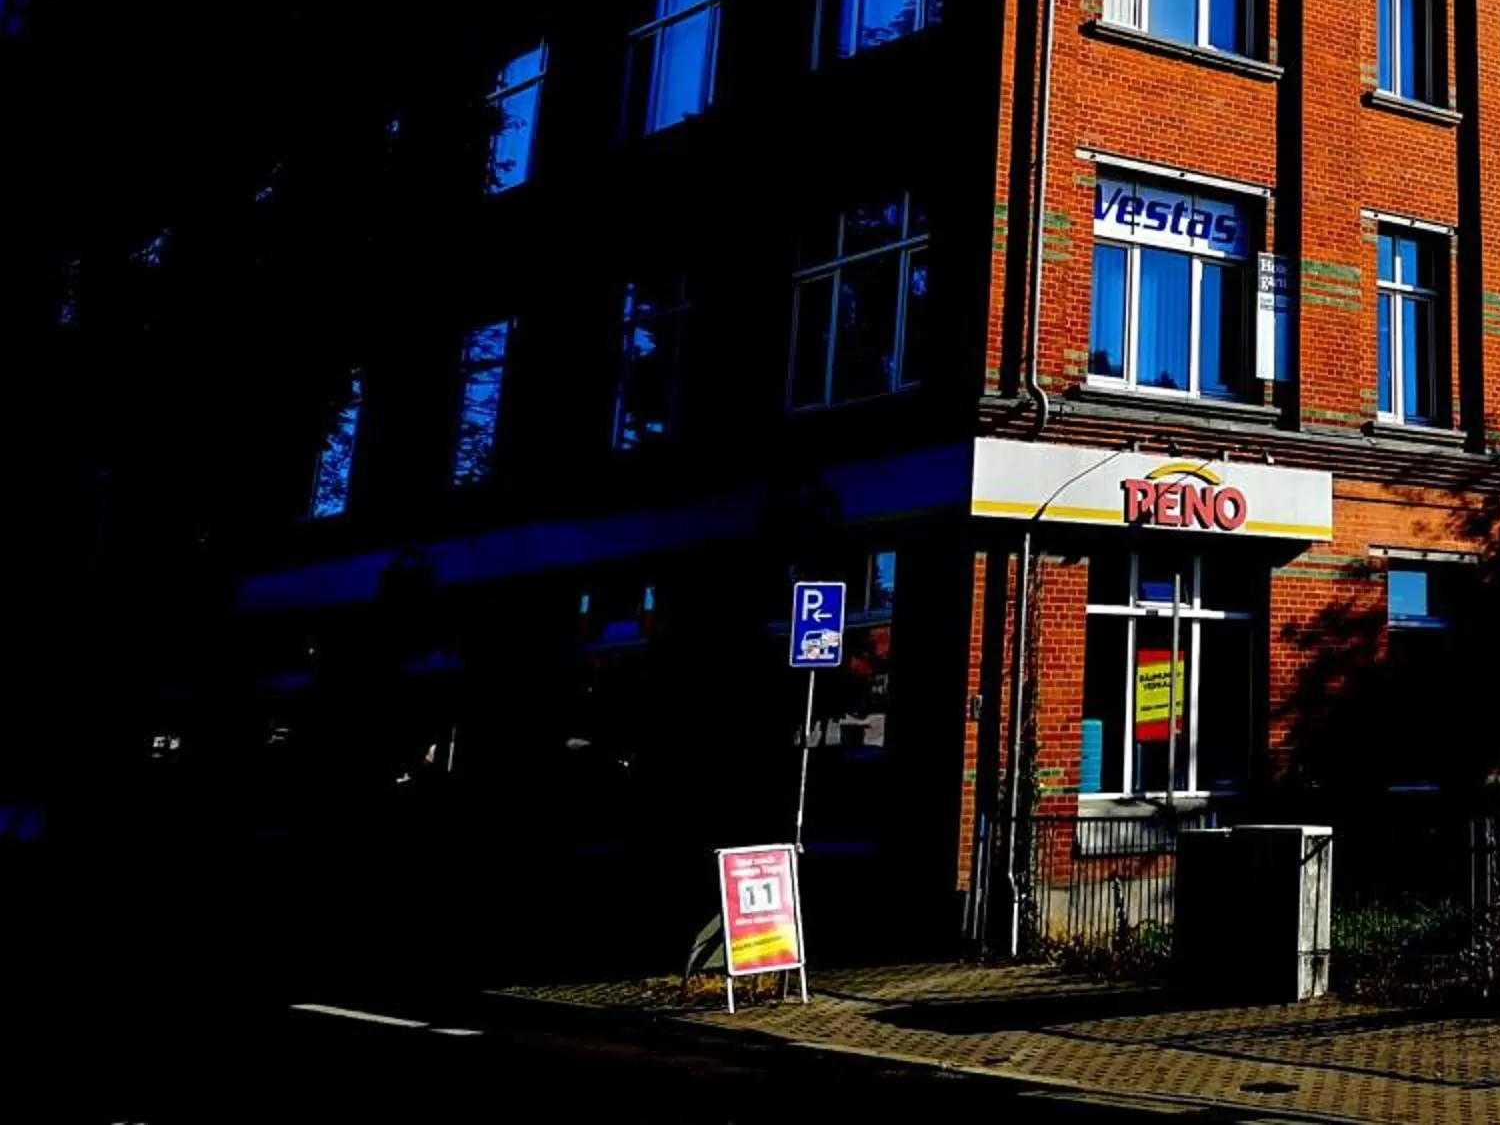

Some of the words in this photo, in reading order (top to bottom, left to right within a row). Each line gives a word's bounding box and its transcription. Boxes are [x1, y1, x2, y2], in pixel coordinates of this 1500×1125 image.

[1095, 184, 1239, 244] Vestas
[1120, 478, 1247, 530] RENO
[802, 589, 823, 621] P
